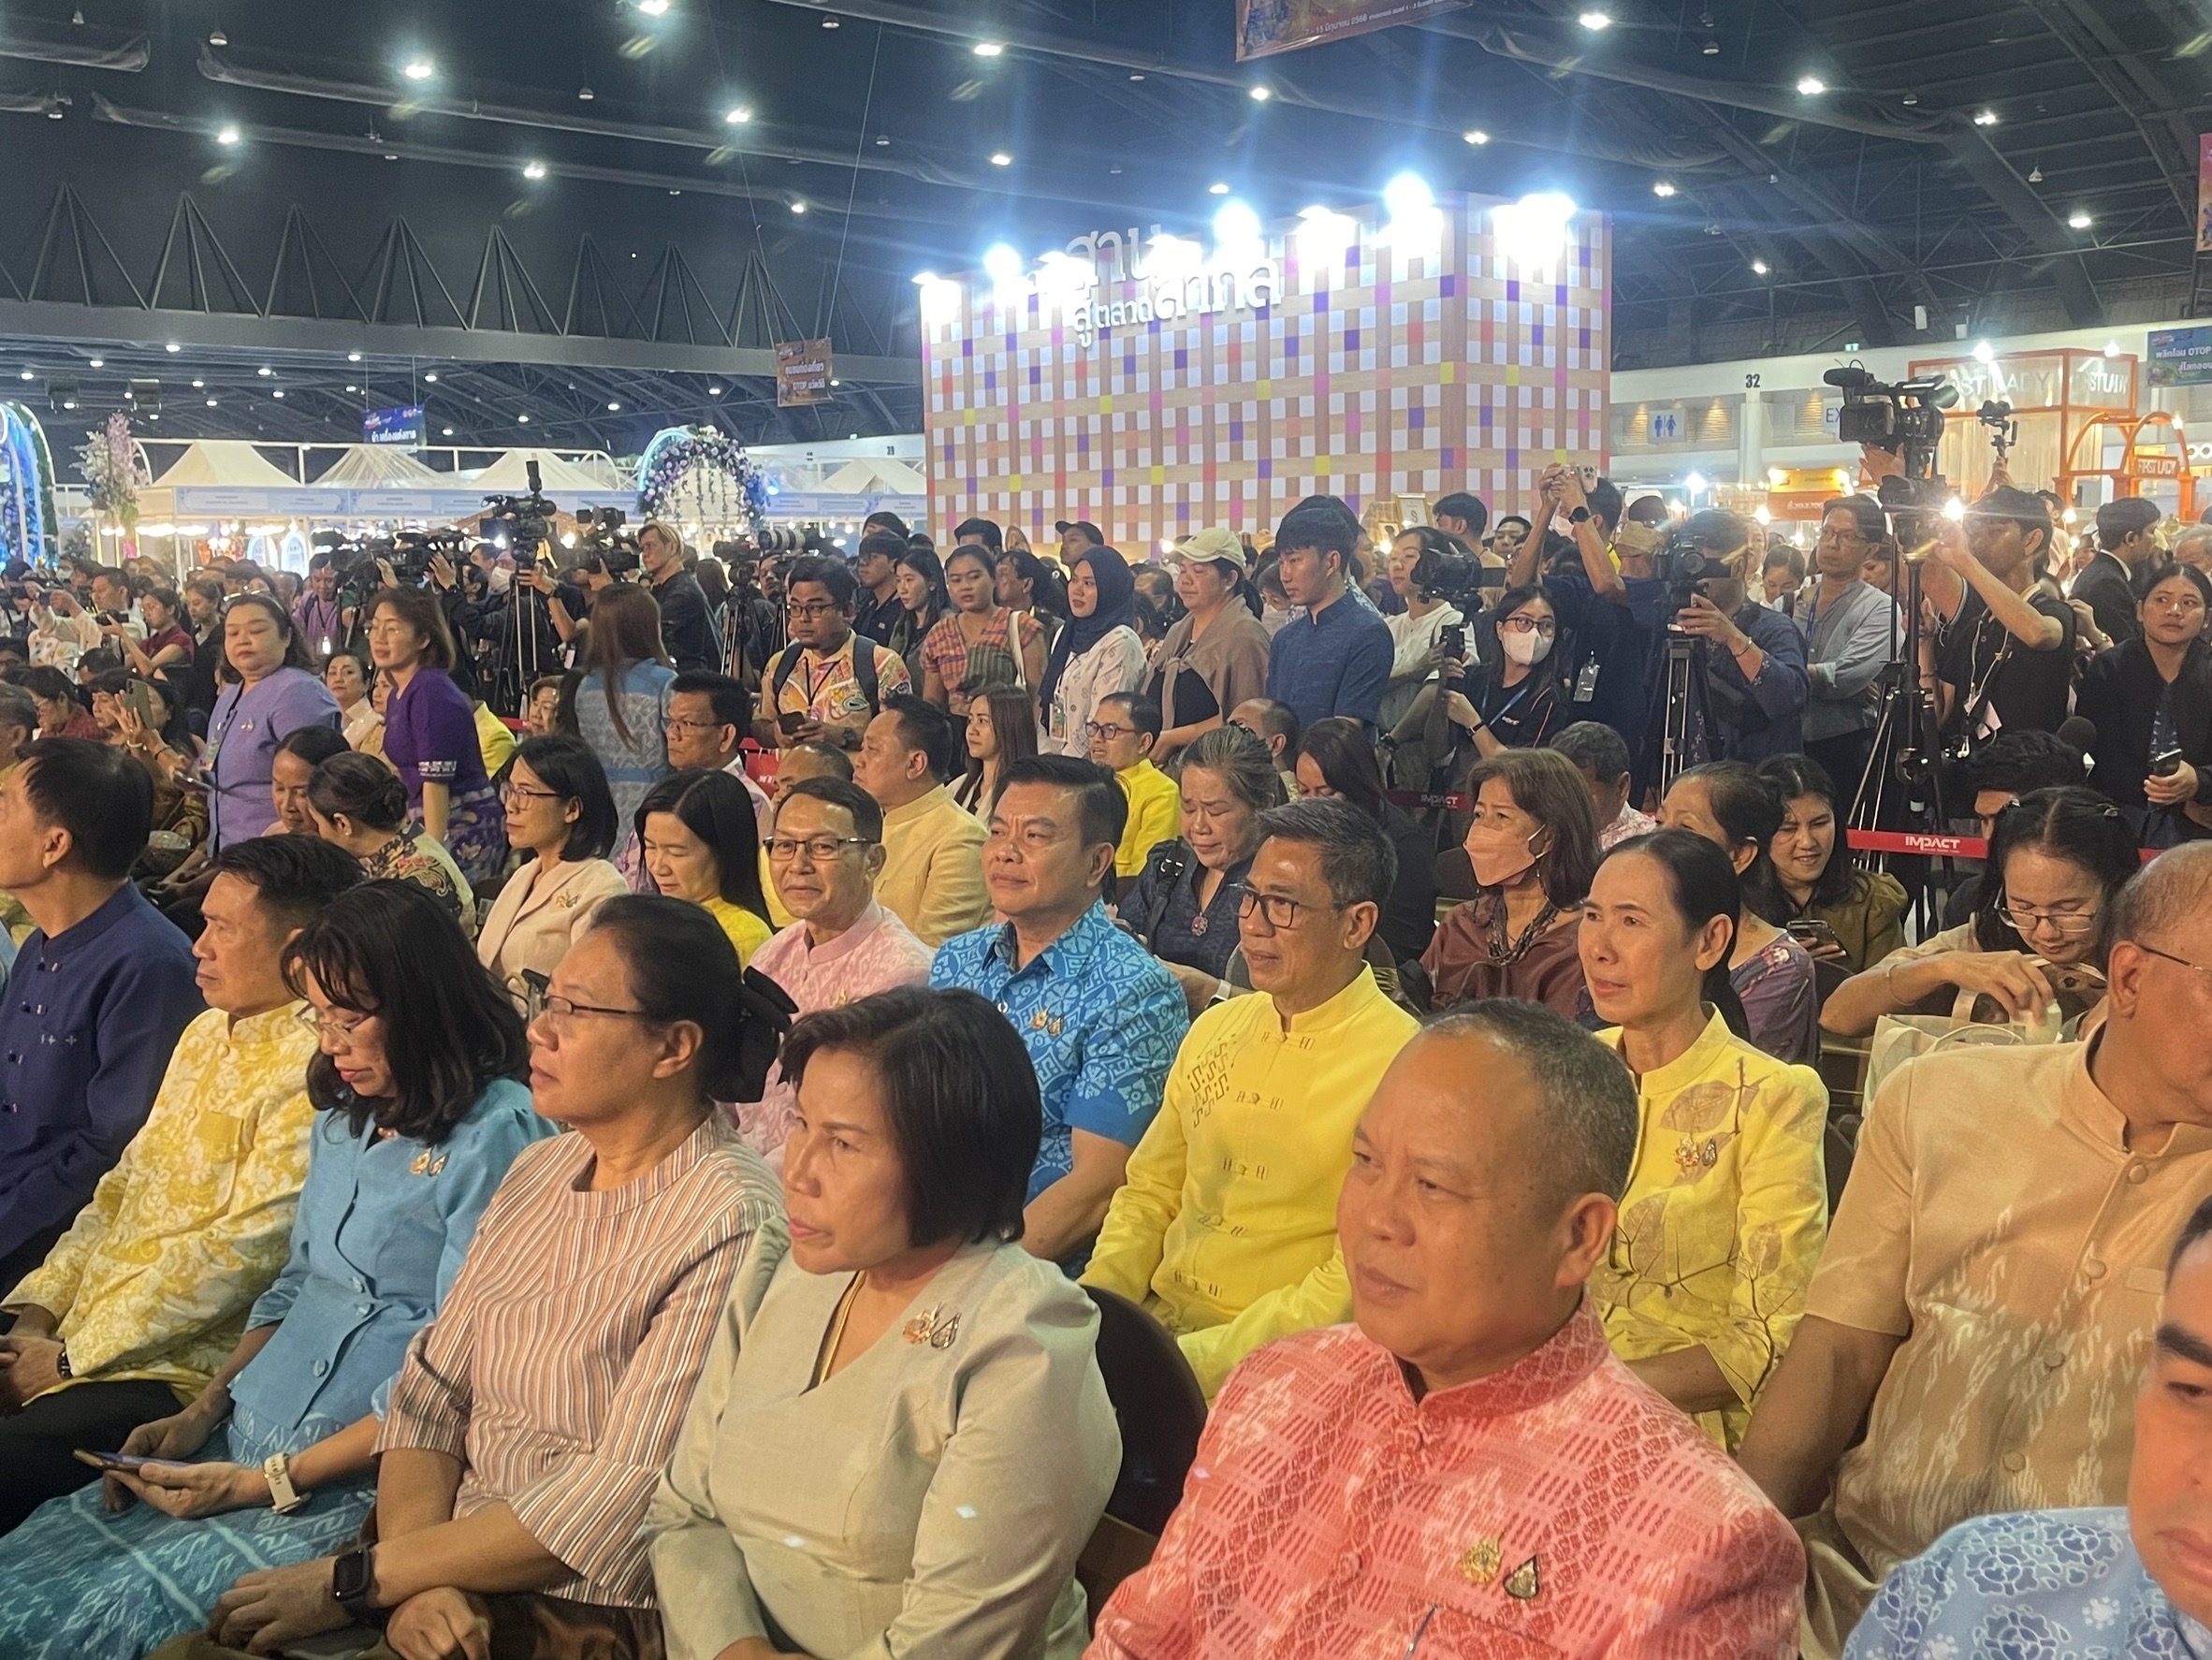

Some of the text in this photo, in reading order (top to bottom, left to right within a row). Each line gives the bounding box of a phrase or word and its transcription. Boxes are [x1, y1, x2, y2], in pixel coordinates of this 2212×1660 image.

[2188, 345, 2212, 357] OTOP
[1745, 373, 1760, 388] 32
[1420, 794, 1458, 807] IMPACT
[1905, 836, 1960, 851] IMPACT
